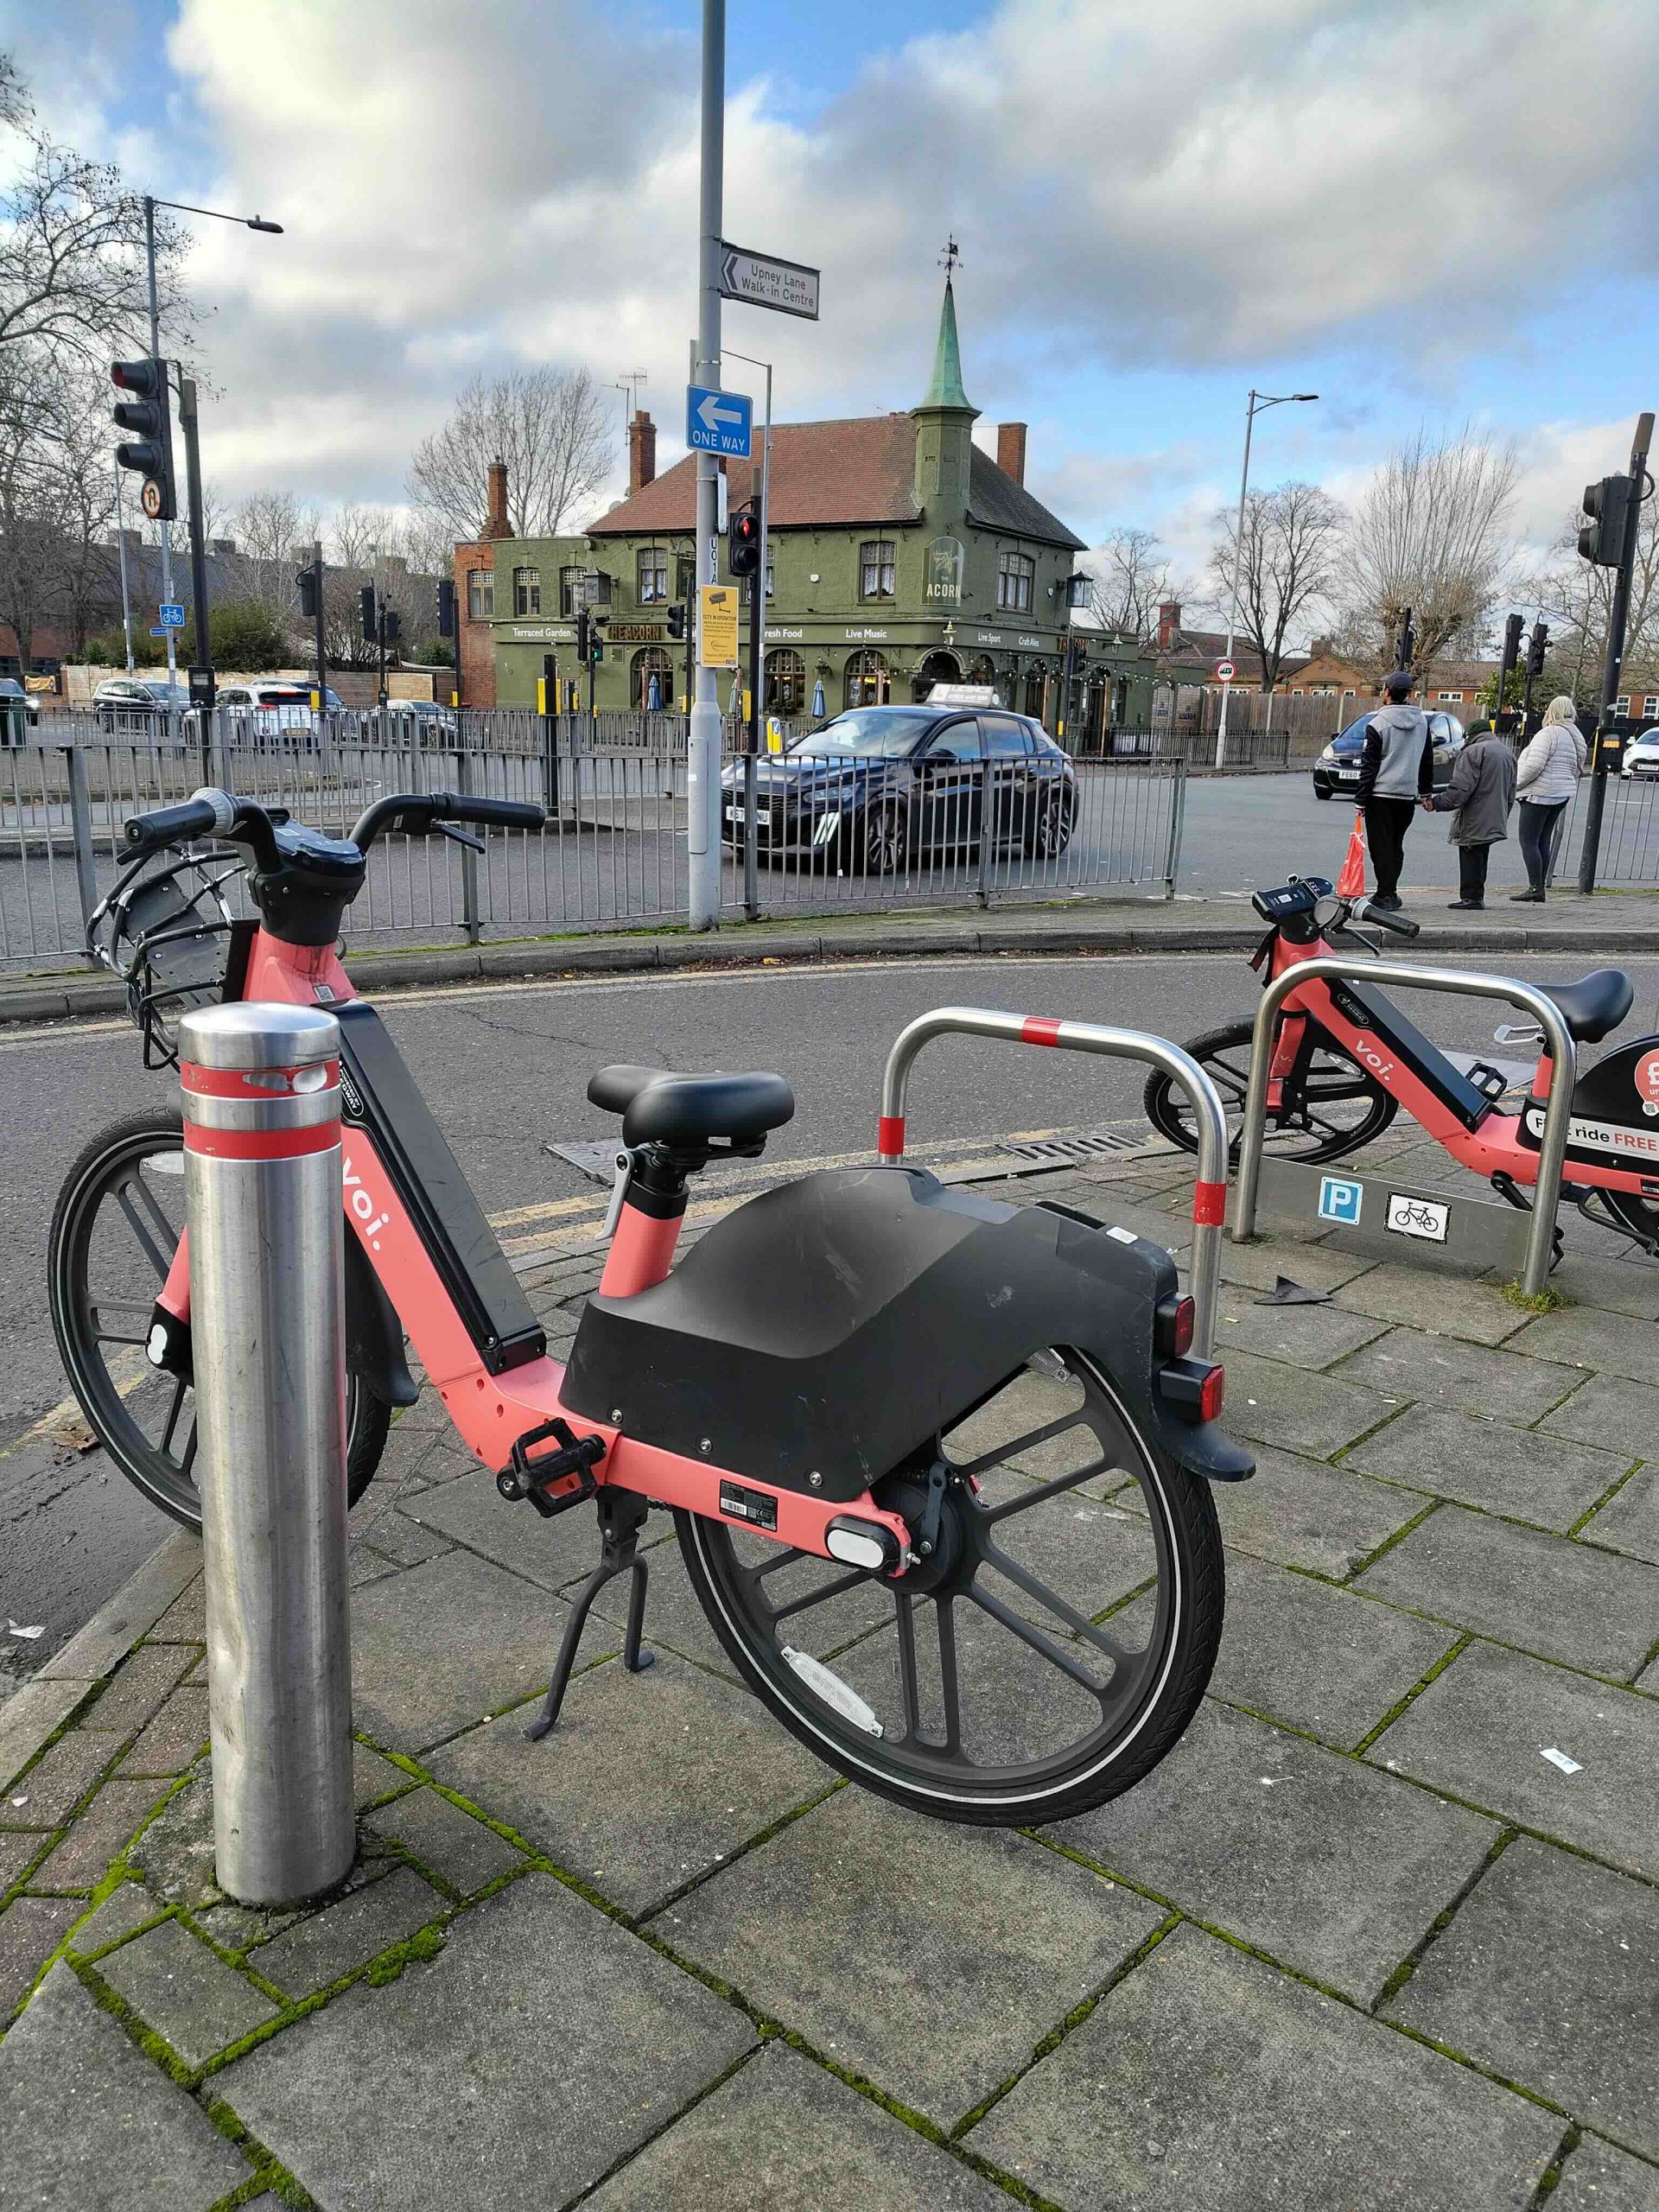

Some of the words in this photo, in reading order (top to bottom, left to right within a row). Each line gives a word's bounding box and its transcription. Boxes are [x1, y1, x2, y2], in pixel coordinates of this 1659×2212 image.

[751, 264, 781, 285] Upney
[785, 271, 805, 289] Lane
[783, 289, 814, 308] Centre
[692, 431, 718, 448] ONE
[721, 436, 746, 452] WAY
[926, 583, 961, 598] ACORN
[512, 627, 543, 637] Terraced
[545, 627, 571, 637] Garden
[764, 628, 781, 638] resh
[783, 628, 803, 638] Food
[845, 628, 862, 638] Live
[864, 629, 887, 638] Music
[978, 632, 988, 642] Live
[988, 632, 1001, 645] Sport
[1356, 1039, 1395, 1081] voi.
[1575, 1126, 1610, 1142] ride
[1614, 1133, 1657, 1152] FREE
[1328, 1184, 1352, 1214] P
